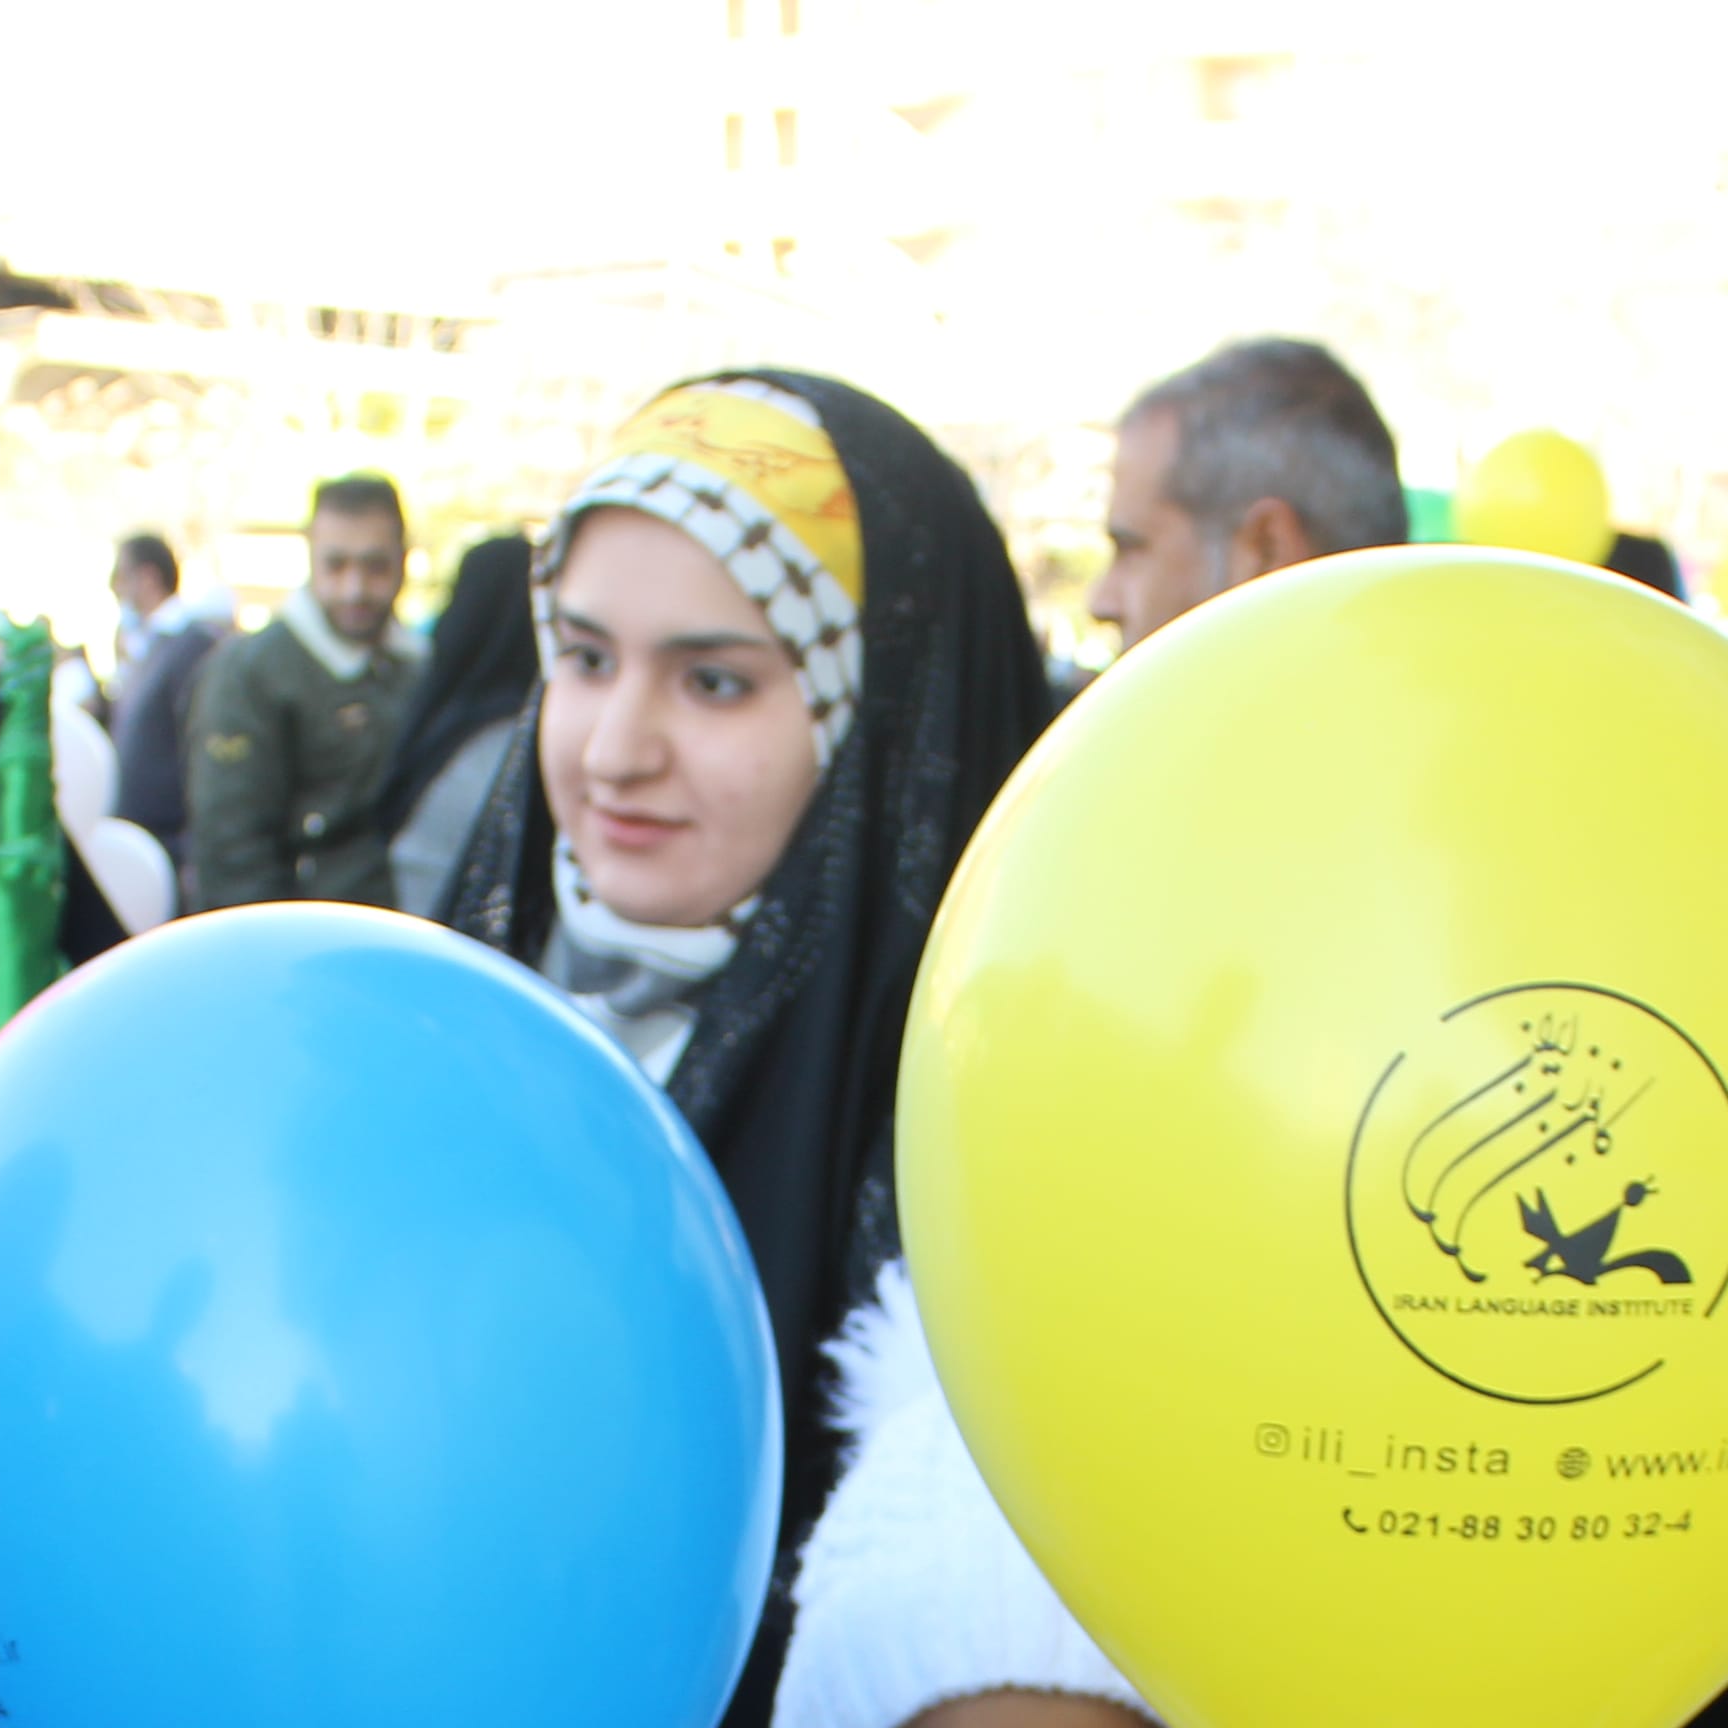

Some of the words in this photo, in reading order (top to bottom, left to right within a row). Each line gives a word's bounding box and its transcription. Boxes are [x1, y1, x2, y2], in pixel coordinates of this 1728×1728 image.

[1393, 1292, 1449, 1312] IRAN
[1455, 1296, 1580, 1317] LANGUAGE
[1586, 1296, 1695, 1318] INSTITUTE
[1300, 1425, 1513, 1479] ili_insta
[1378, 1508, 1501, 1541] 021-88
[1516, 1514, 1557, 1542] 30
[1570, 1513, 1610, 1541] 80
[1623, 1508, 1694, 1540] 32-4
